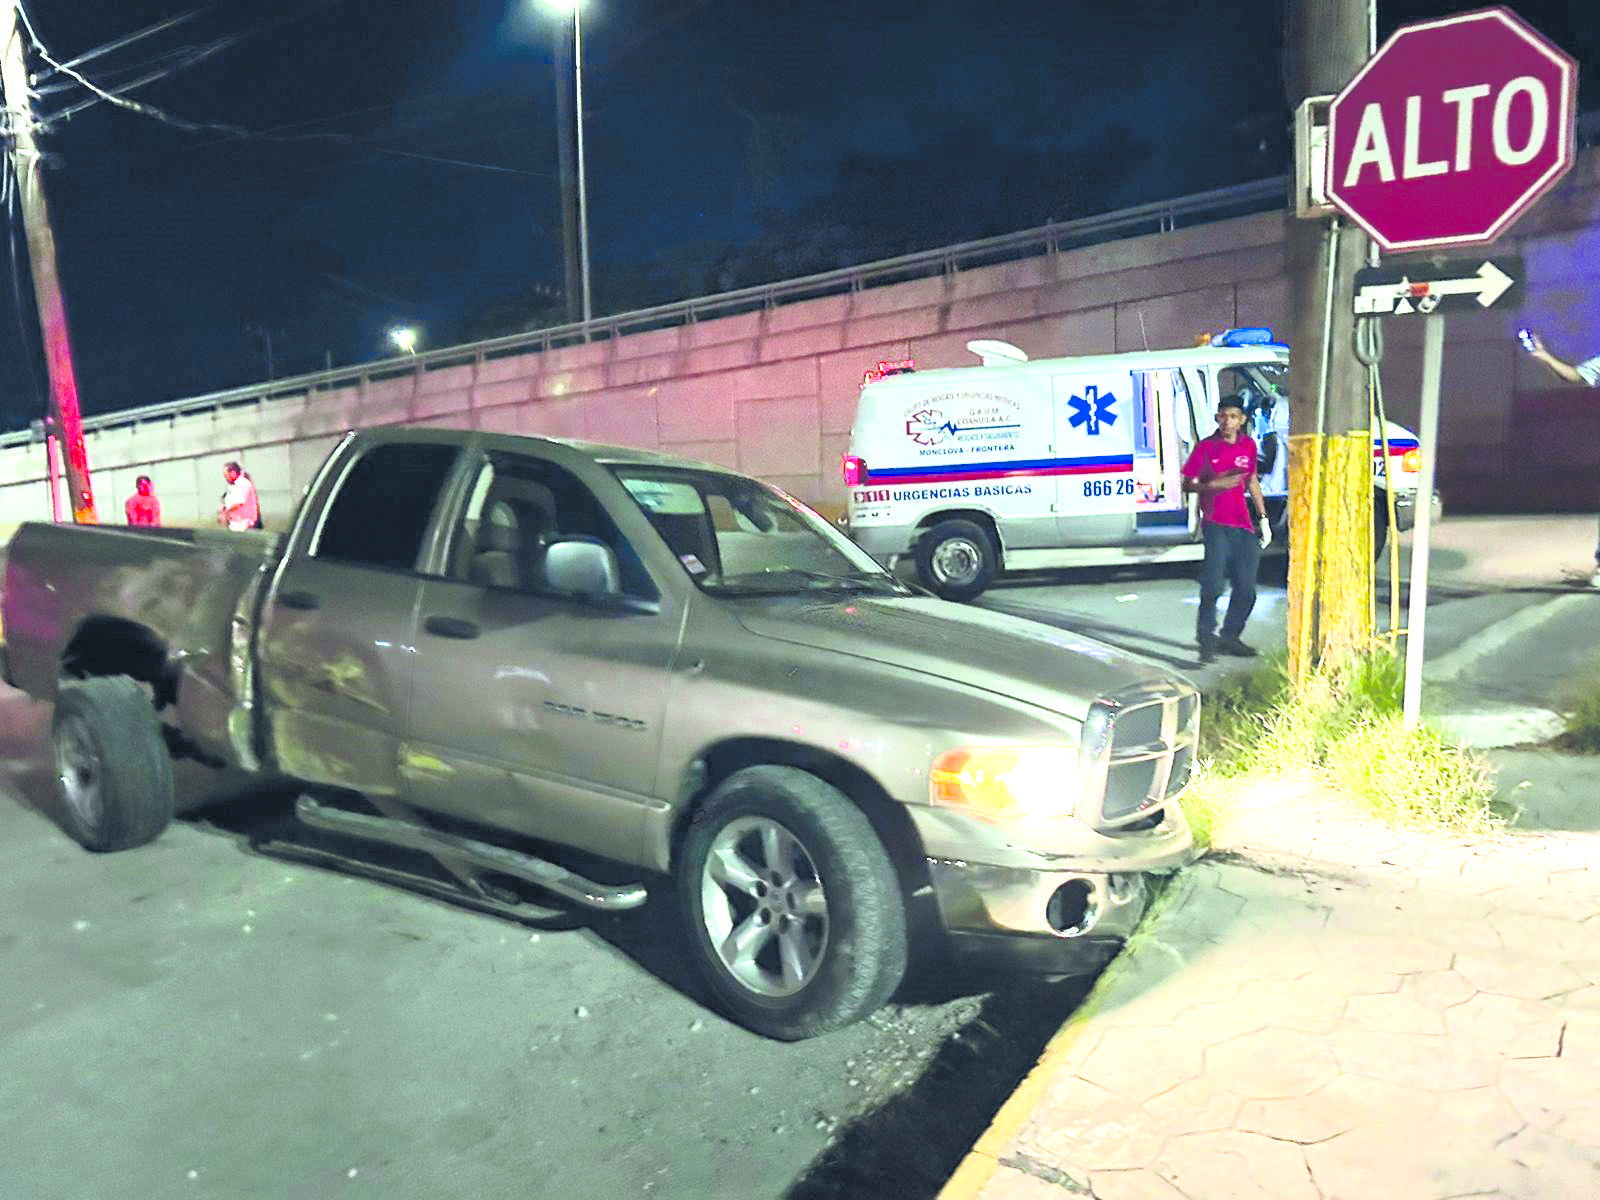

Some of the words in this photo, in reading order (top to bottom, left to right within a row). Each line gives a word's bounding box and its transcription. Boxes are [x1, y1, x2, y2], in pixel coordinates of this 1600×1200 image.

[1343, 75, 1549, 188] ALTO
[919, 447, 964, 456] MONCLOVA
[970, 443, 1015, 453] FRONTERA
[893, 487, 970, 501] URGENCIAS
[975, 484, 1032, 497] BASICAS
[1083, 480, 1112, 497] 866
[1116, 478, 1134, 495] 26
